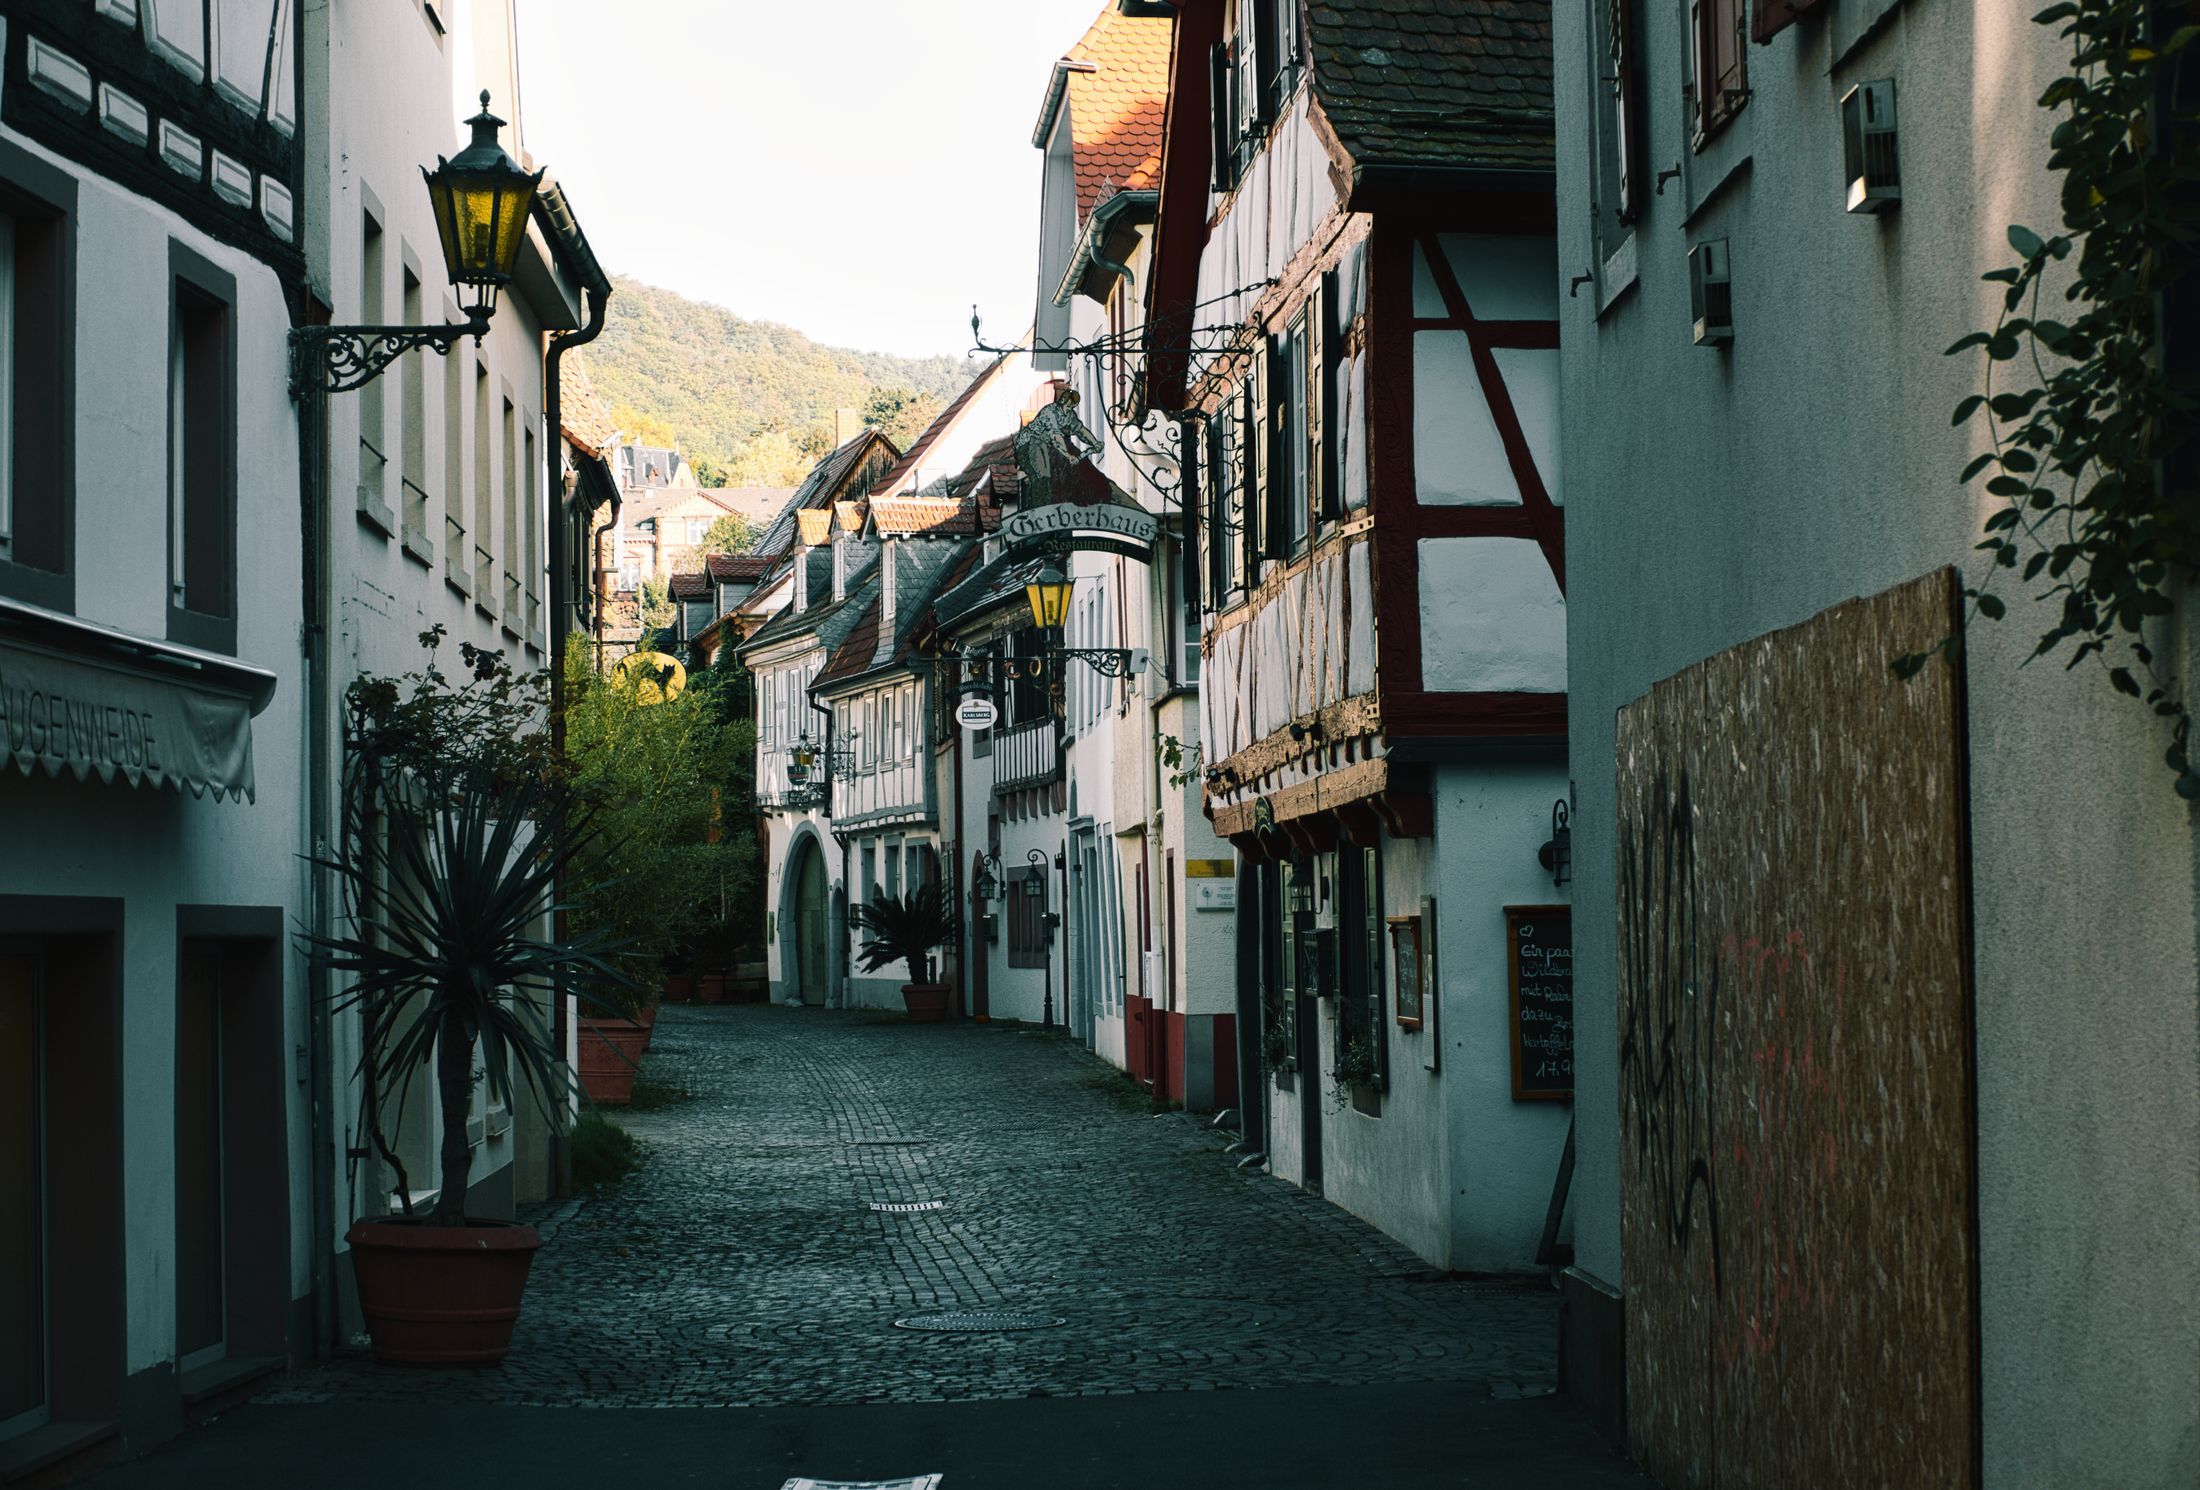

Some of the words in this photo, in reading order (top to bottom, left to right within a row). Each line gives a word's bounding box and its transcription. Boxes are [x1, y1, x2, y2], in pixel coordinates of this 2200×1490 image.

[1009, 504, 1151, 537] Gerberhaus
[1044, 539, 1116, 552] Restaurant
[1521, 944, 1544, 957] Ein
[1546, 947, 1573, 968] paa
[1521, 961, 1573, 977] Wildbra
[1520, 983, 1542, 996] mit
[1521, 1005, 1553, 1020] dazu
